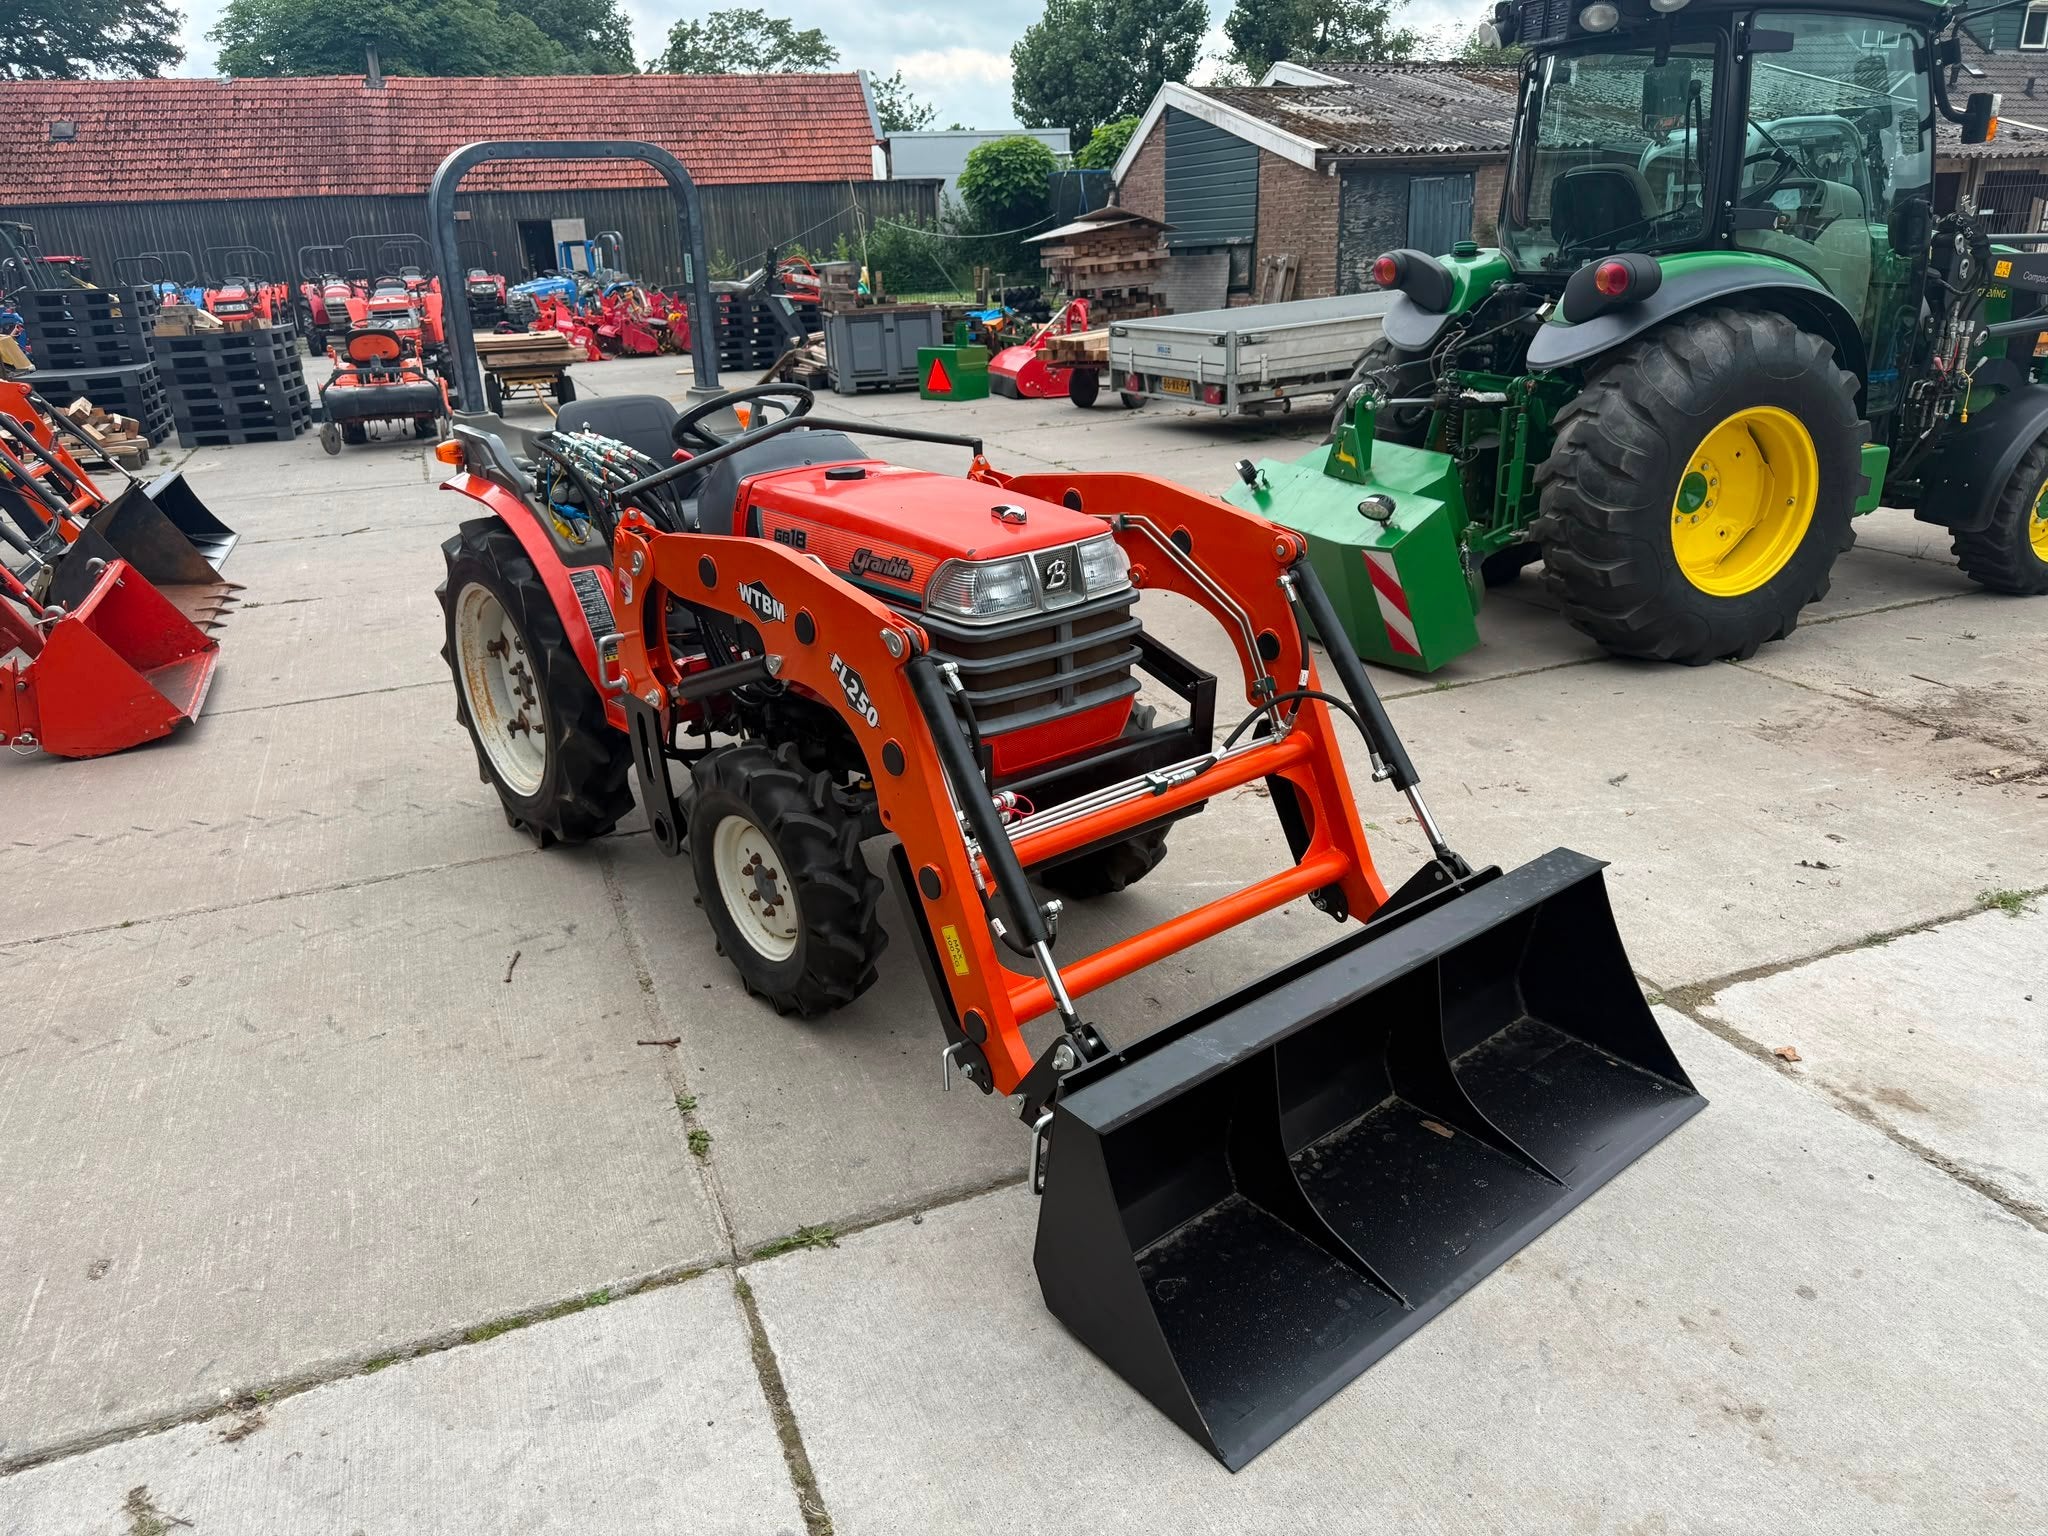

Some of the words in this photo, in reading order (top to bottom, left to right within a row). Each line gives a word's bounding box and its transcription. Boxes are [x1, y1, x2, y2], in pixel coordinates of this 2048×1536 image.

[774, 528, 806, 549] GB18
[1046, 559, 1067, 588] B
[738, 581, 786, 623] WTBM
[830, 652, 879, 728] FL250
[953, 940, 962, 960] MAX
